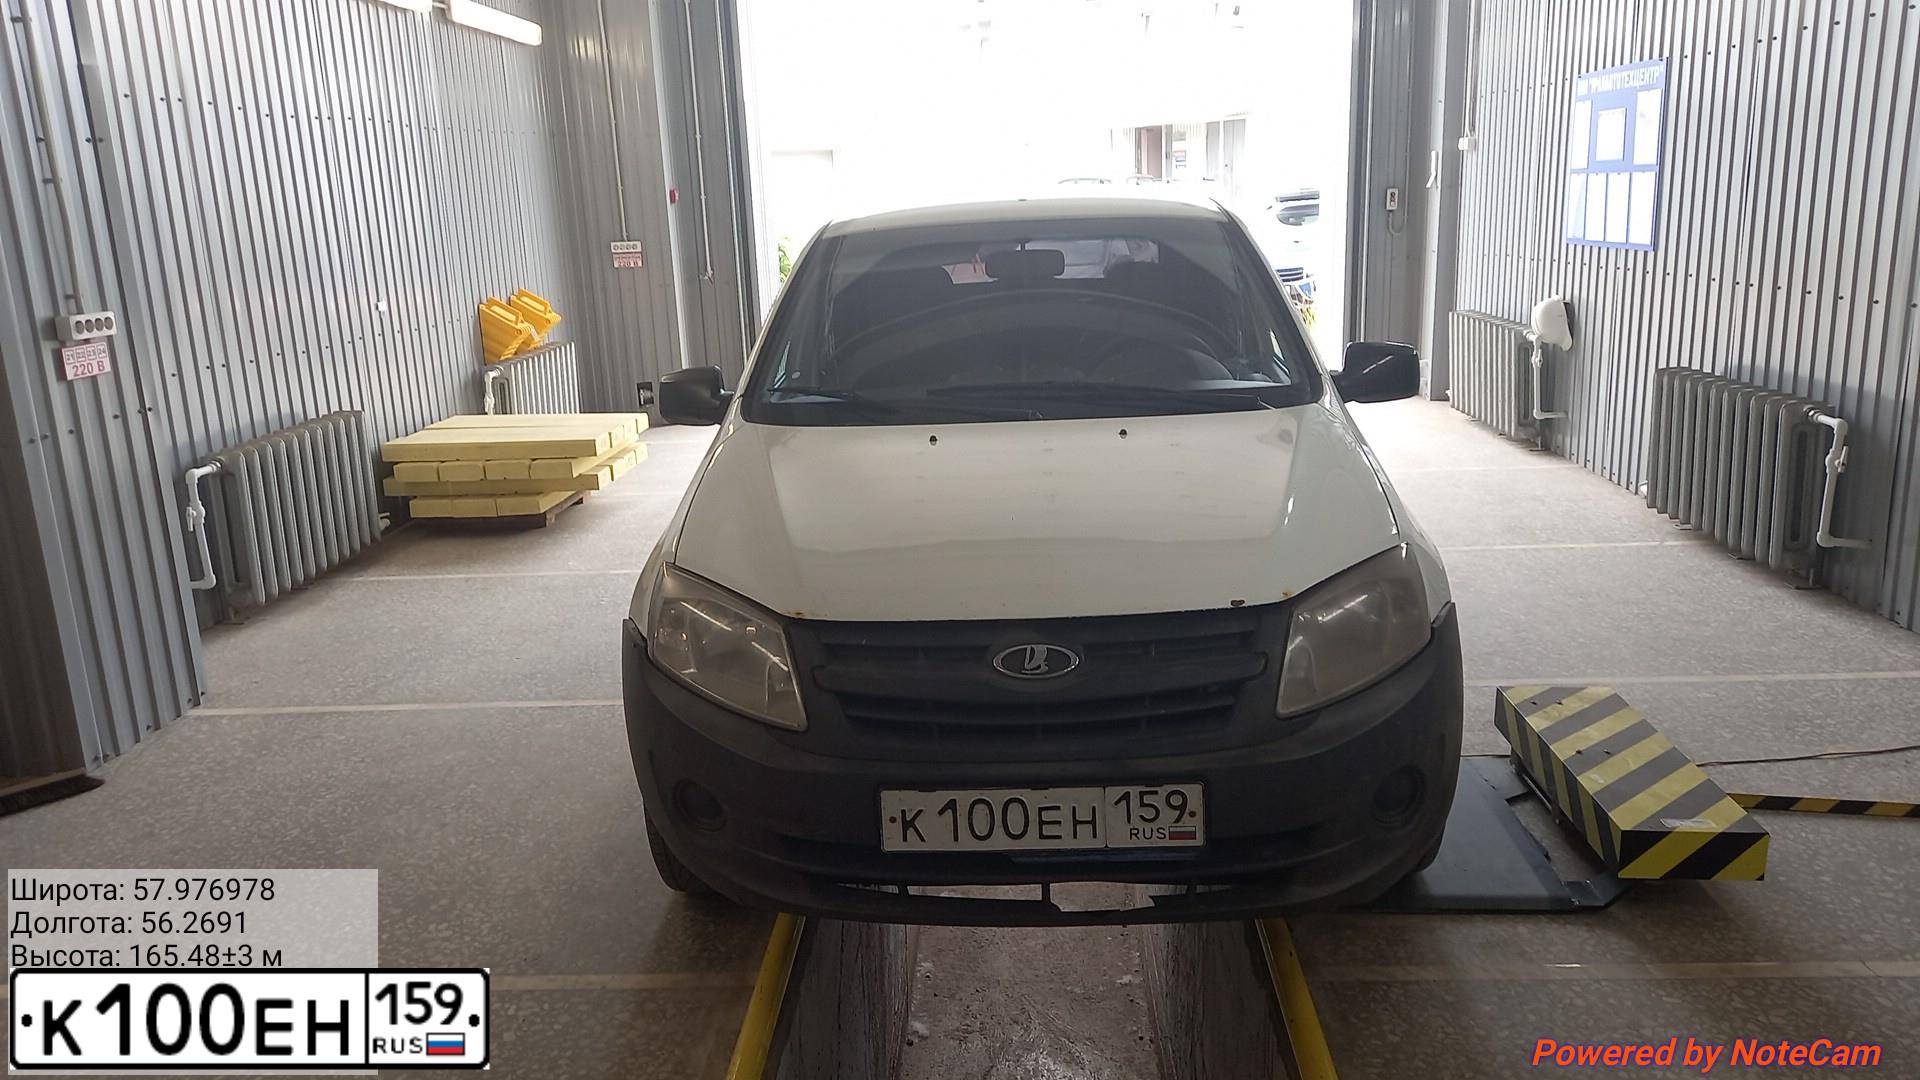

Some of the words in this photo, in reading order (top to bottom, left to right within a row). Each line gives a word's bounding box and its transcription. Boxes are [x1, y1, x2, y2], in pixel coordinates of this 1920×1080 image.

[72, 362, 94, 377] 220
[900, 796, 1098, 843] К100ЕН
[1113, 789, 1190, 824] 159
[1129, 827, 1167, 841] RUS
